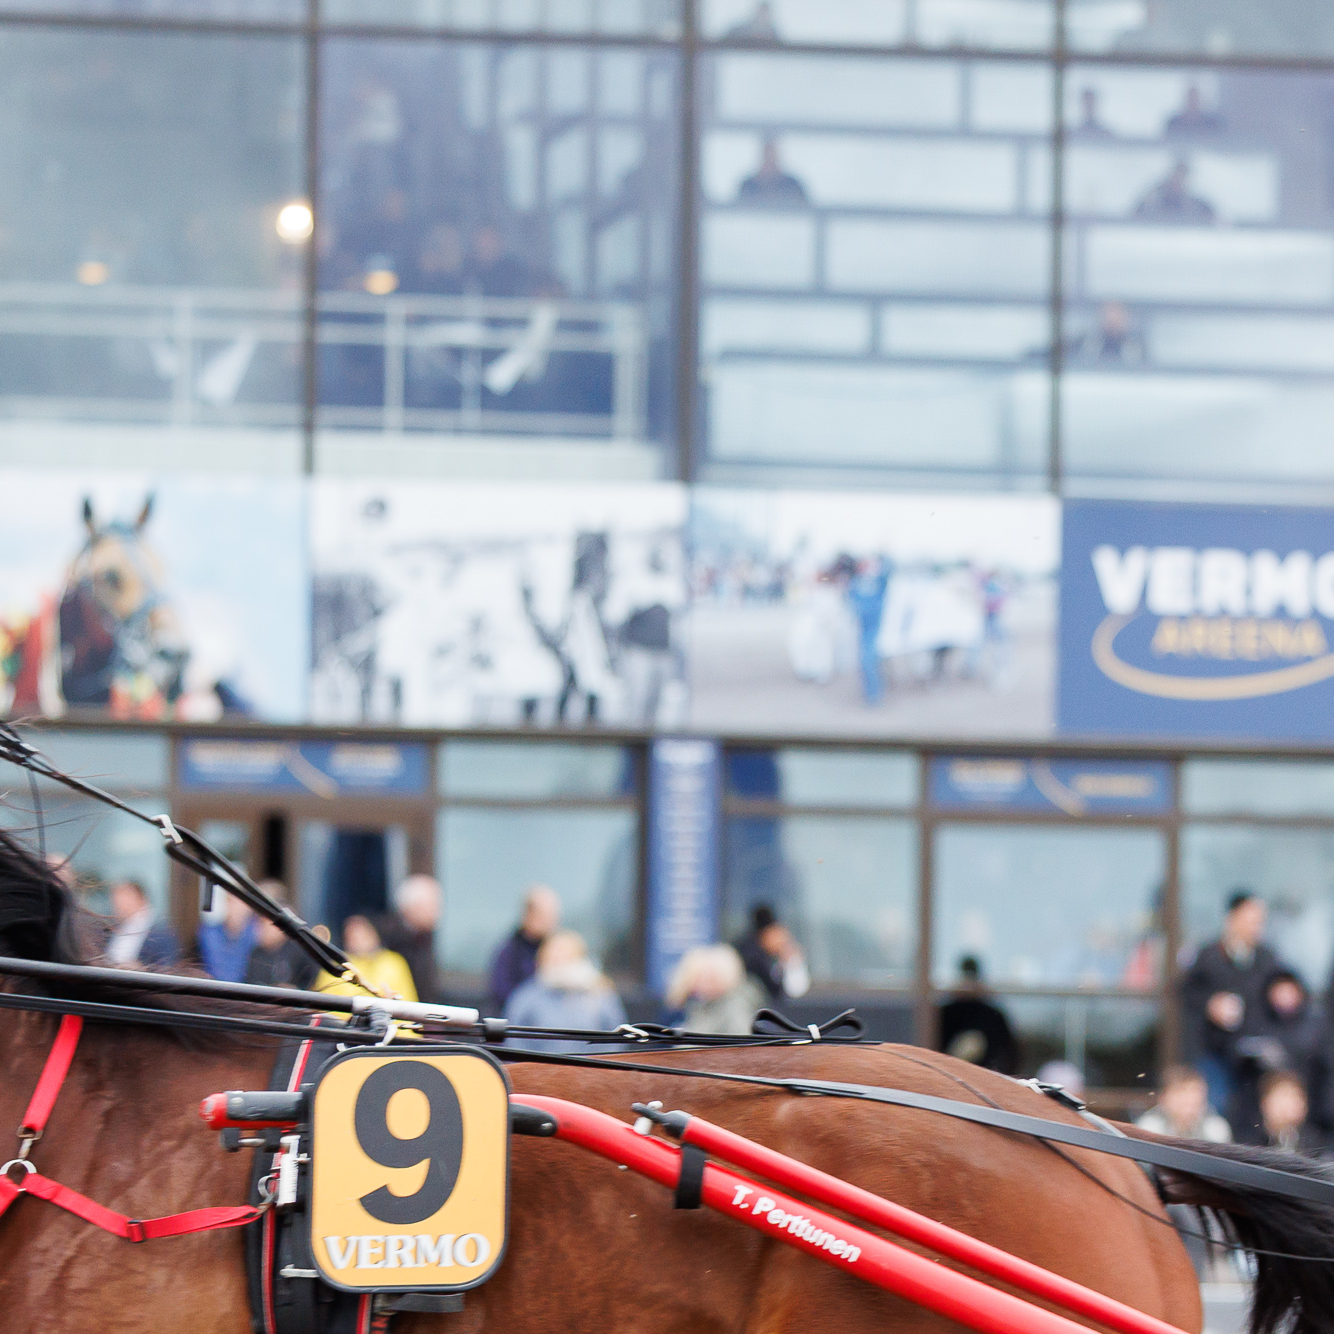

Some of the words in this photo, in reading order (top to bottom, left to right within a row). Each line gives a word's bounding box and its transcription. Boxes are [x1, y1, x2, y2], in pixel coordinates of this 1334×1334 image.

[355, 1060, 463, 1225] 9
[323, 1232, 492, 1270] VERMO
[731, 1184, 754, 1209] T.
[751, 1196, 863, 1263] Perttunen
